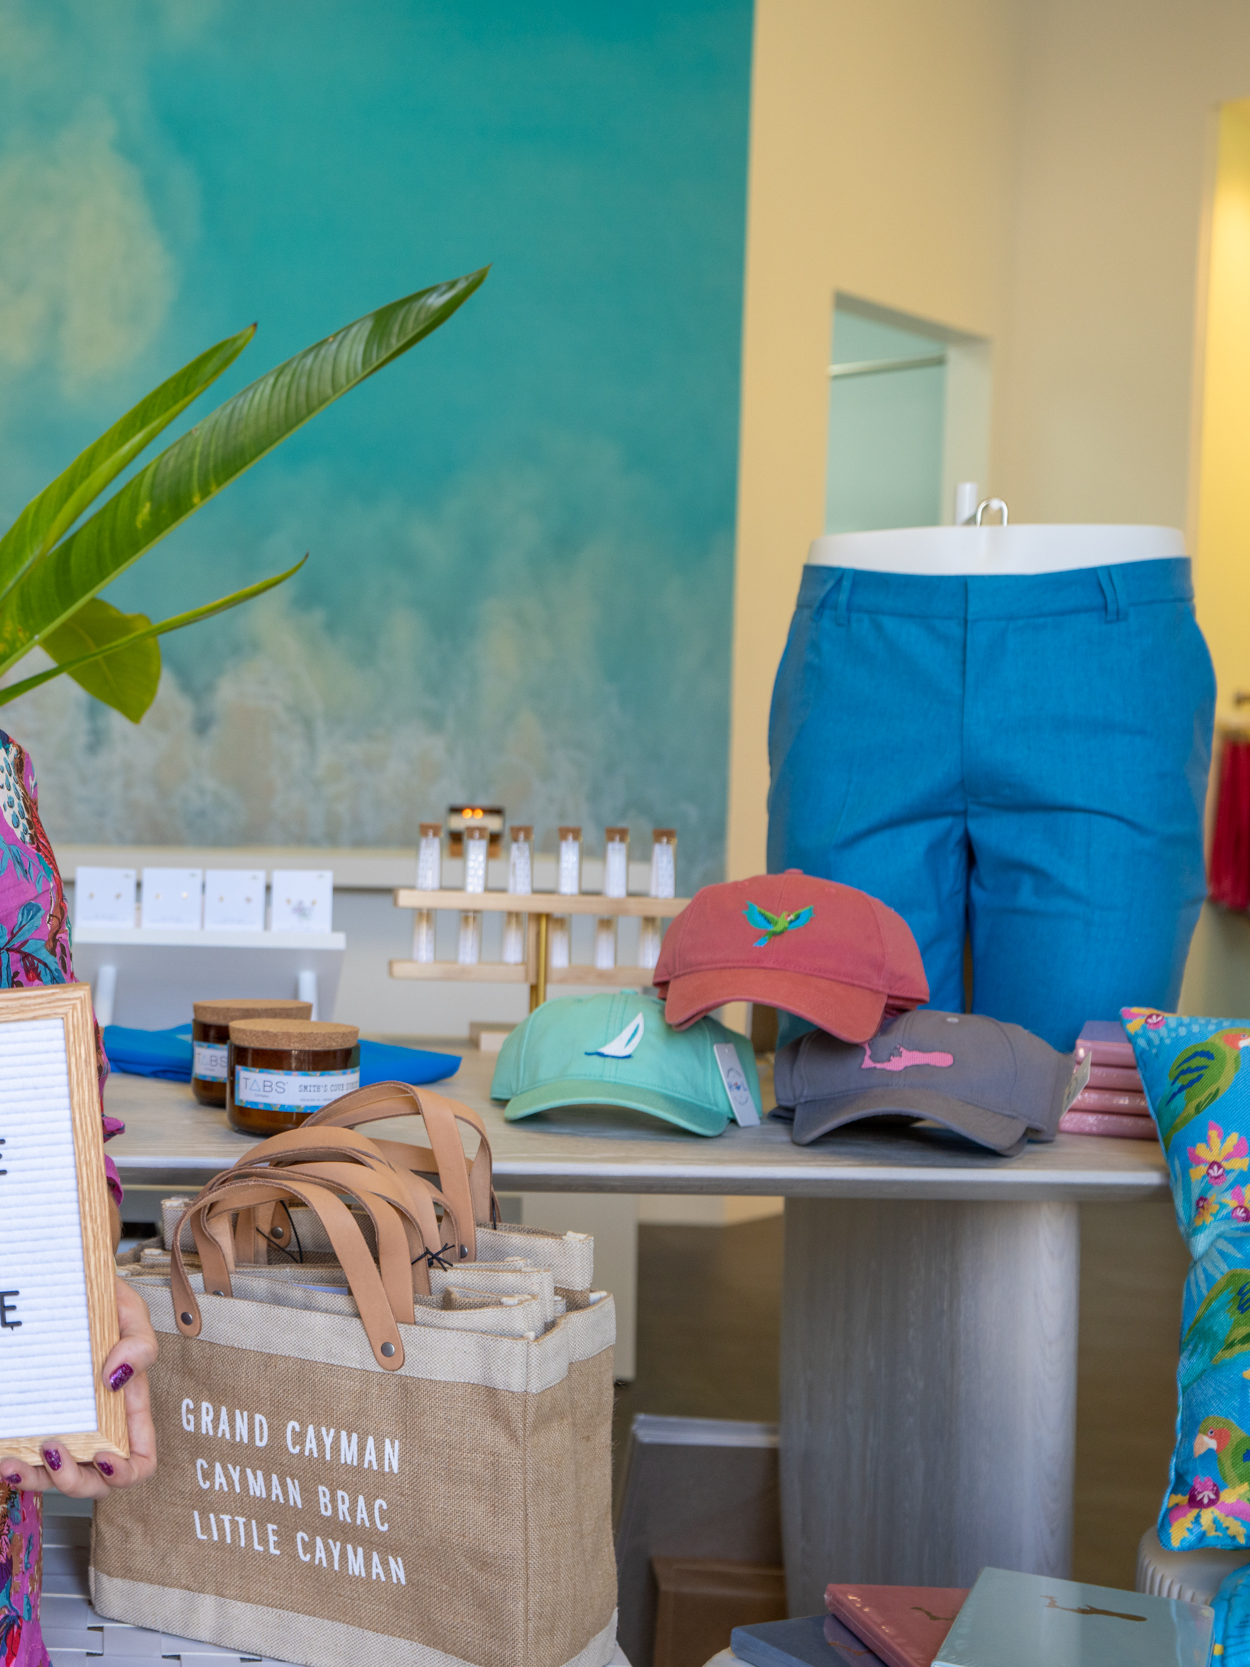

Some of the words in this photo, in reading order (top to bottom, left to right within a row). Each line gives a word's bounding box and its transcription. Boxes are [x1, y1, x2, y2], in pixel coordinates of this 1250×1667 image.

[242, 1077, 287, 1094] TABS
[298, 1084, 329, 1093] SMITH'S
[330, 1083, 345, 1092] COVE
[181, 1398, 269, 1447] GRAND
[286, 1420, 400, 1474] CAYMAN
[196, 1458, 303, 1509] CAYMAN
[318, 1485, 389, 1532] BRAC
[193, 1510, 281, 1556] LITTLE
[296, 1531, 406, 1586] CAYMAN
